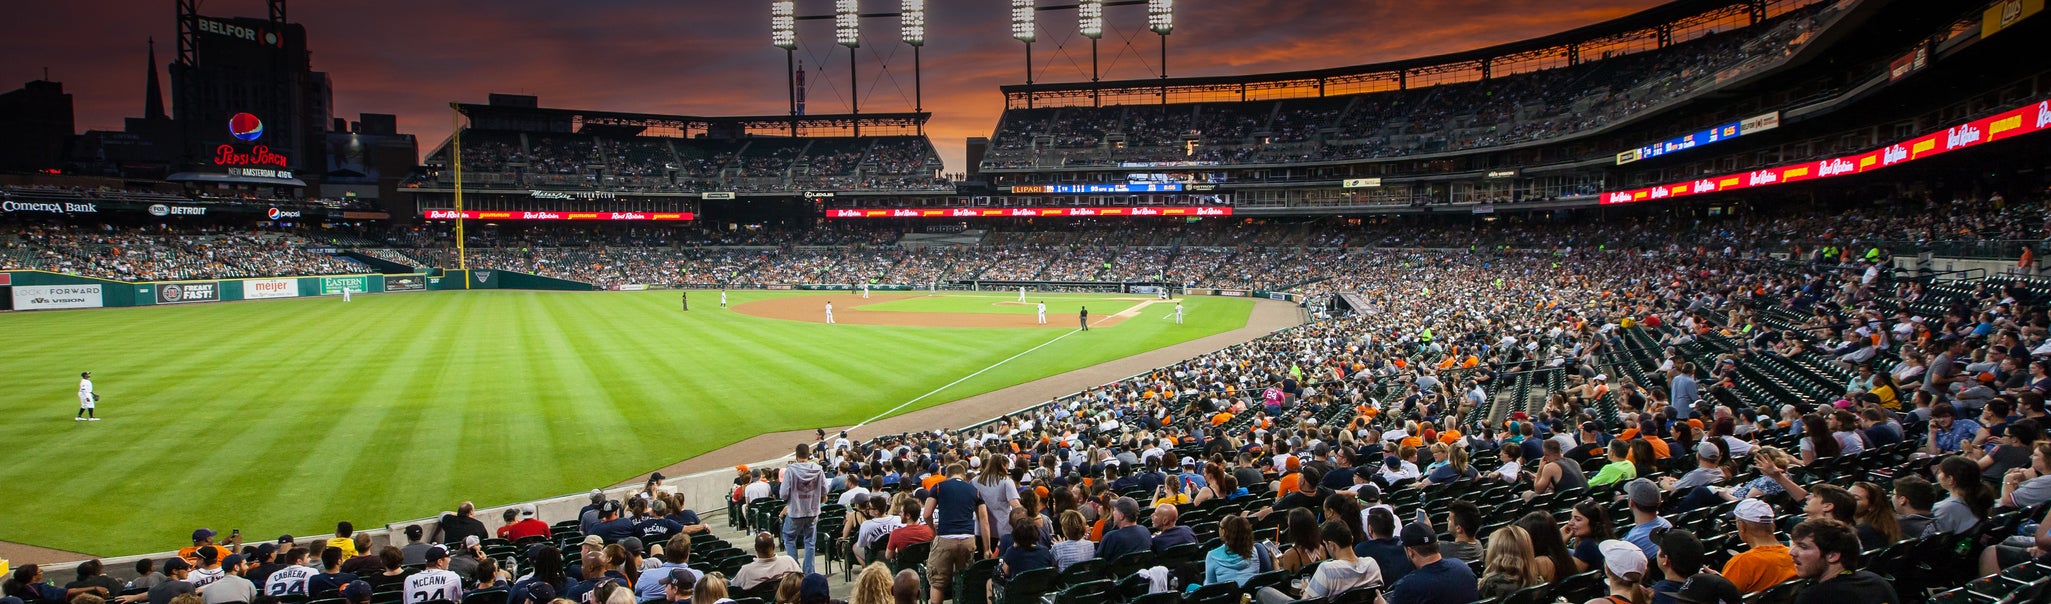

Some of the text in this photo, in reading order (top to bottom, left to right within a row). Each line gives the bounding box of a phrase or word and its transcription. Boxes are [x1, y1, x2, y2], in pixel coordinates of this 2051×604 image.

[199, 19, 255, 40] BELFOR
[2037, 101, 2051, 128] Re
[228, 167, 242, 176] NEW
[242, 168, 276, 178] AMSTERDAM
[65, 202, 98, 213] Bank
[171, 206, 206, 215] DETROIT
[255, 280, 288, 292] meijer
[326, 278, 362, 286] EASTERN
[50, 287, 100, 295] FORWARD
[183, 290, 213, 300] FAST!
[1266, 391, 1277, 400] 24
[643, 525, 668, 534] McCANN
[274, 570, 307, 582] CABRERA
[412, 576, 447, 588] McCANN
[272, 580, 305, 596] 24
